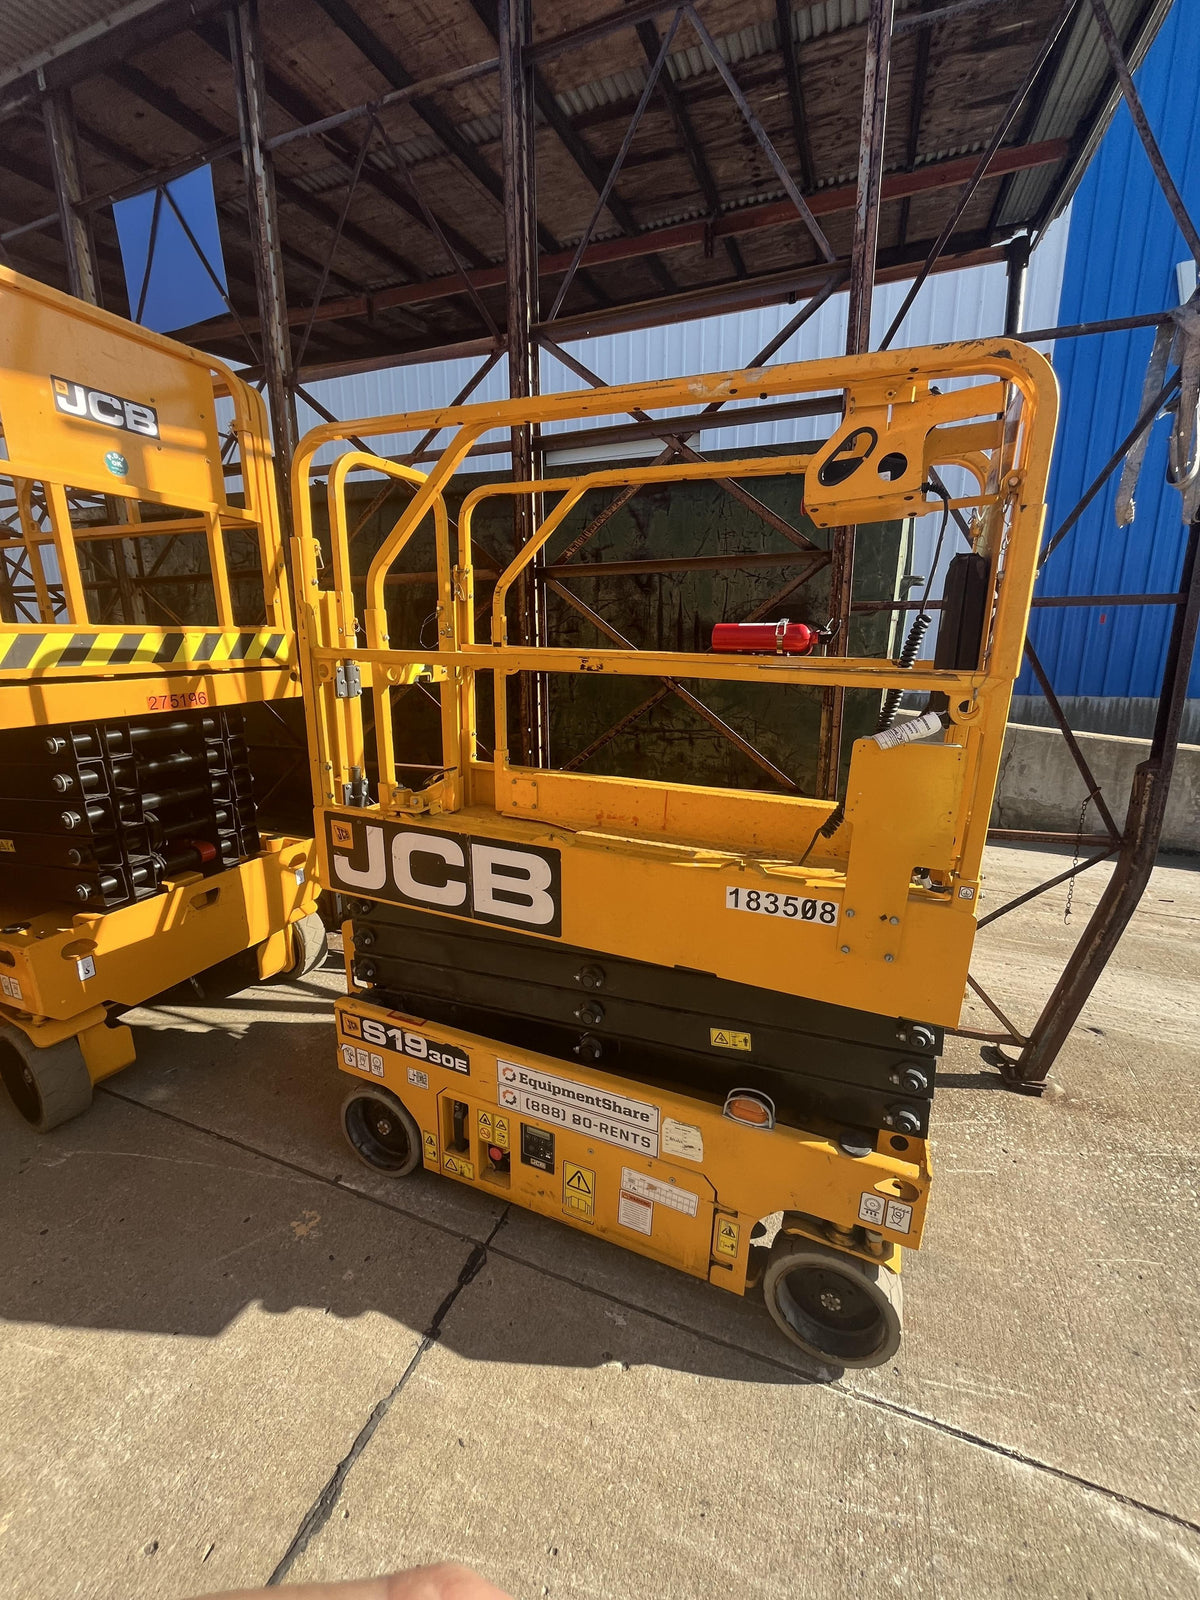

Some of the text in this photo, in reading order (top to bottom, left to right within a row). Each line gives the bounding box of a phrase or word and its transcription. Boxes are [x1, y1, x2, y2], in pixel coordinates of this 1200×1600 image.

[56, 385, 158, 436] JCB
[148, 692, 207, 710] 275196
[333, 825, 555, 925] JCB
[728, 887, 836, 924] 183508
[518, 1071, 651, 1122] EquipmentShare
[525, 1097, 566, 1121] (888)
[572, 1113, 651, 1148] 80-RENTS
